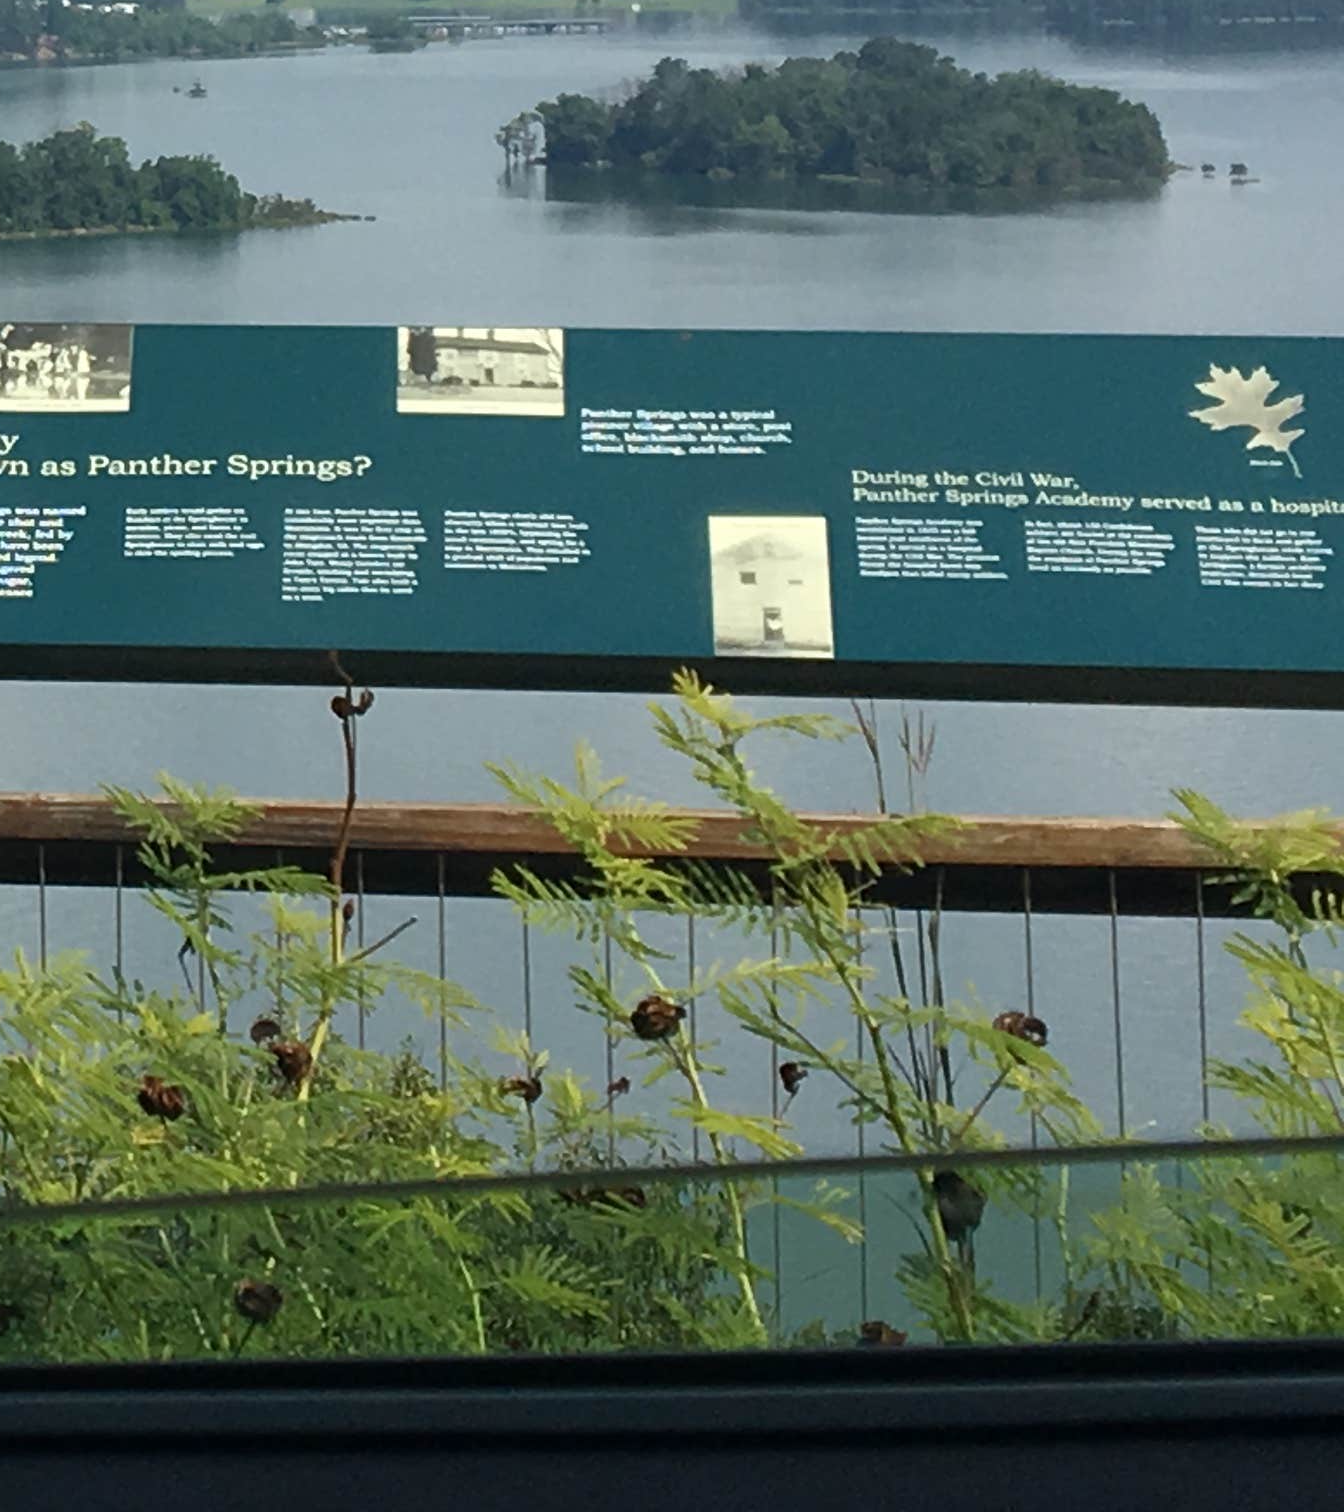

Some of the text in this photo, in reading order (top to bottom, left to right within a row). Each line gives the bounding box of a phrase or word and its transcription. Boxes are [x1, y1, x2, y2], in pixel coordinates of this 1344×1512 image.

[41, 461, 76, 473] as
[89, 454, 216, 474] Panther
[228, 454, 372, 481] Springs?
[852, 470, 1078, 489] During the Civil War,
[854, 486, 938, 502] Panther
[946, 489, 1028, 506] Springs
[1036, 491, 1133, 510] Academy
[1141, 496, 1211, 510] served
[1219, 500, 1243, 511] as
[1251, 502, 1263, 512] a
